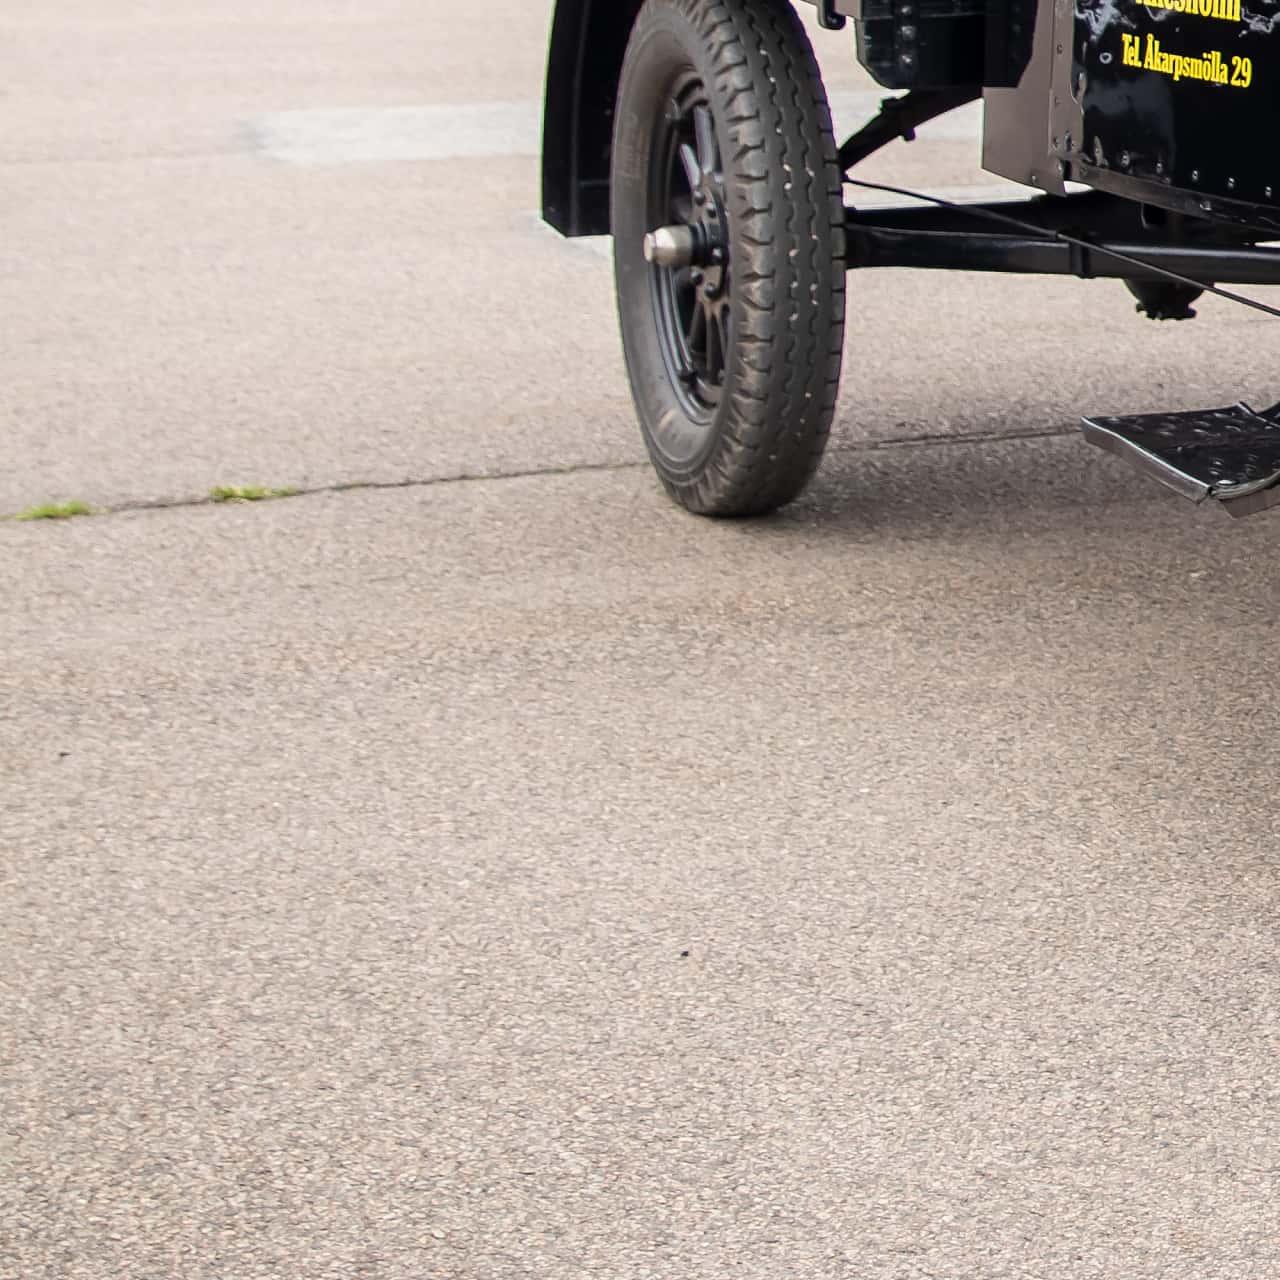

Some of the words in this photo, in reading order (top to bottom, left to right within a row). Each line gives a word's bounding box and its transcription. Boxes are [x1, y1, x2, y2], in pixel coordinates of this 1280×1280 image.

[1121, 33, 1142, 69] Tel.
[1143, 33, 1229, 85] Åkarpsmölla
[1230, 56, 1252, 88] 29
